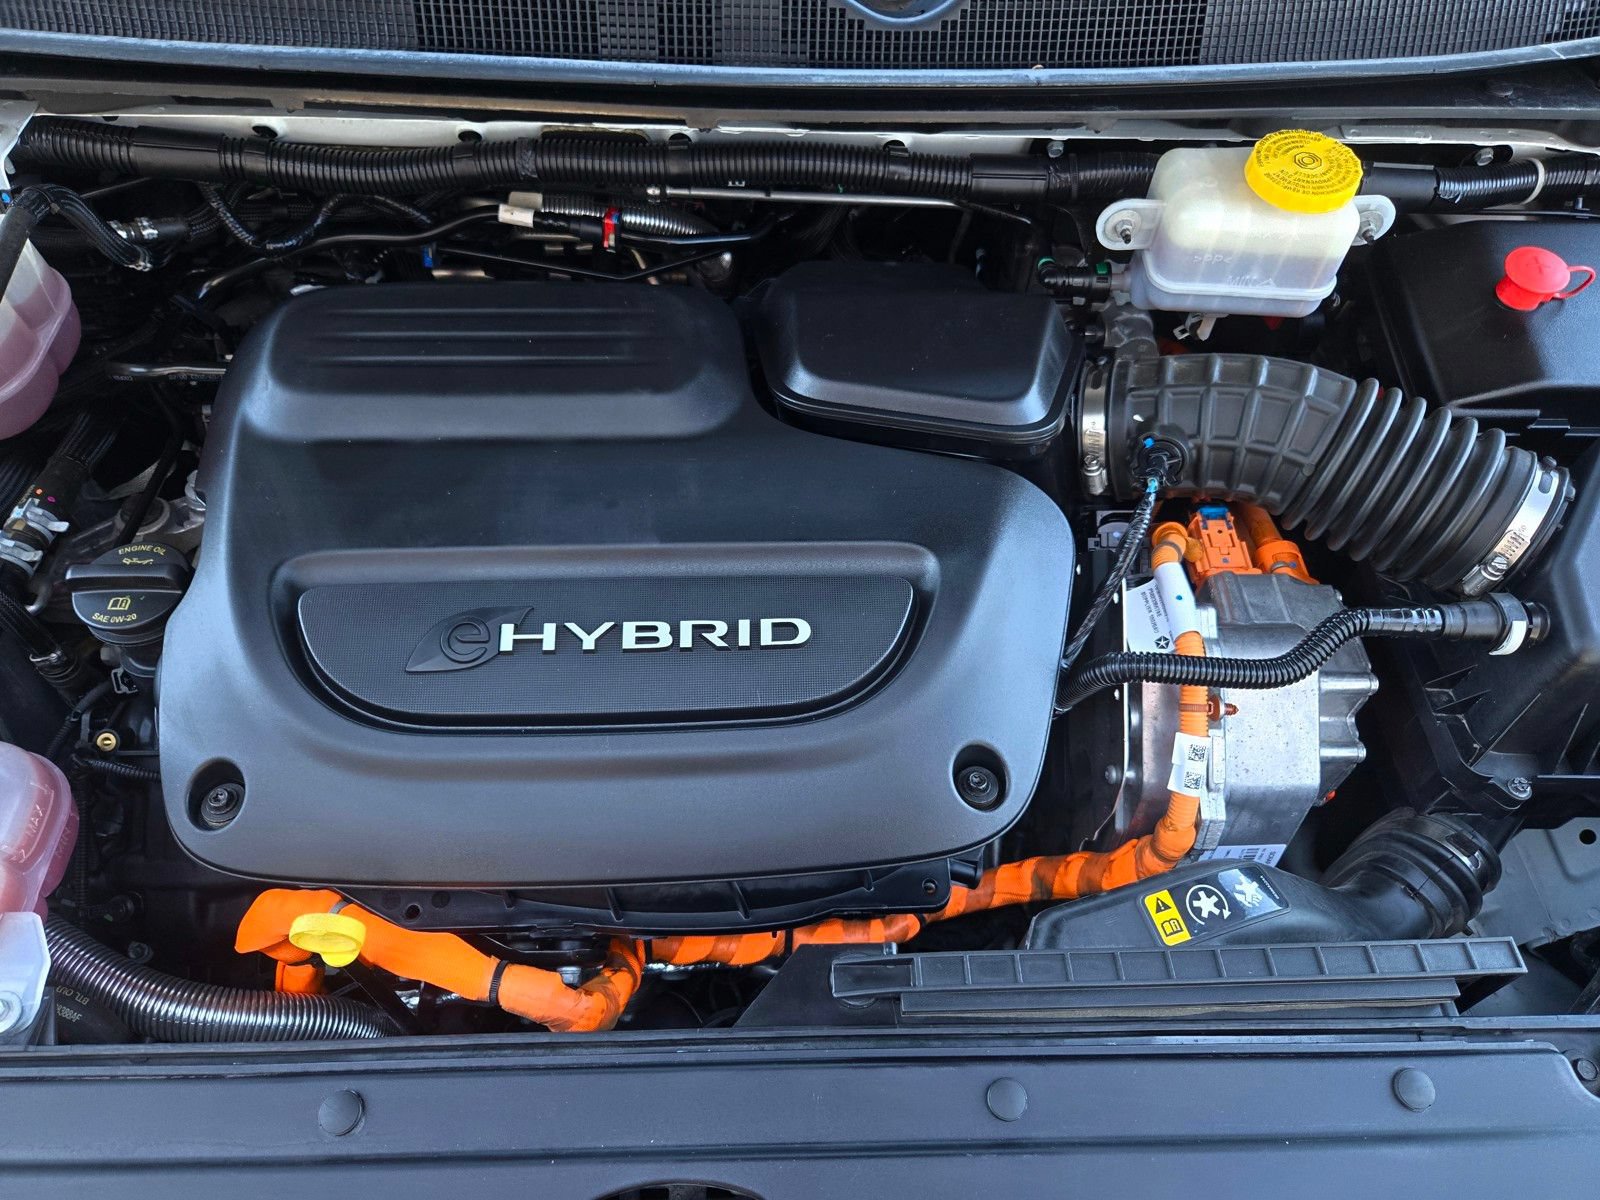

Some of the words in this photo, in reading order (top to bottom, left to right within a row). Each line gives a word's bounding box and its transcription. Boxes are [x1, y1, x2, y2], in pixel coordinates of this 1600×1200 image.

[118, 544, 154, 555] ENGINE
[154, 546, 166, 556] OIL
[92, 612, 110, 622] SAE
[110, 613, 137, 623] 0W-20
